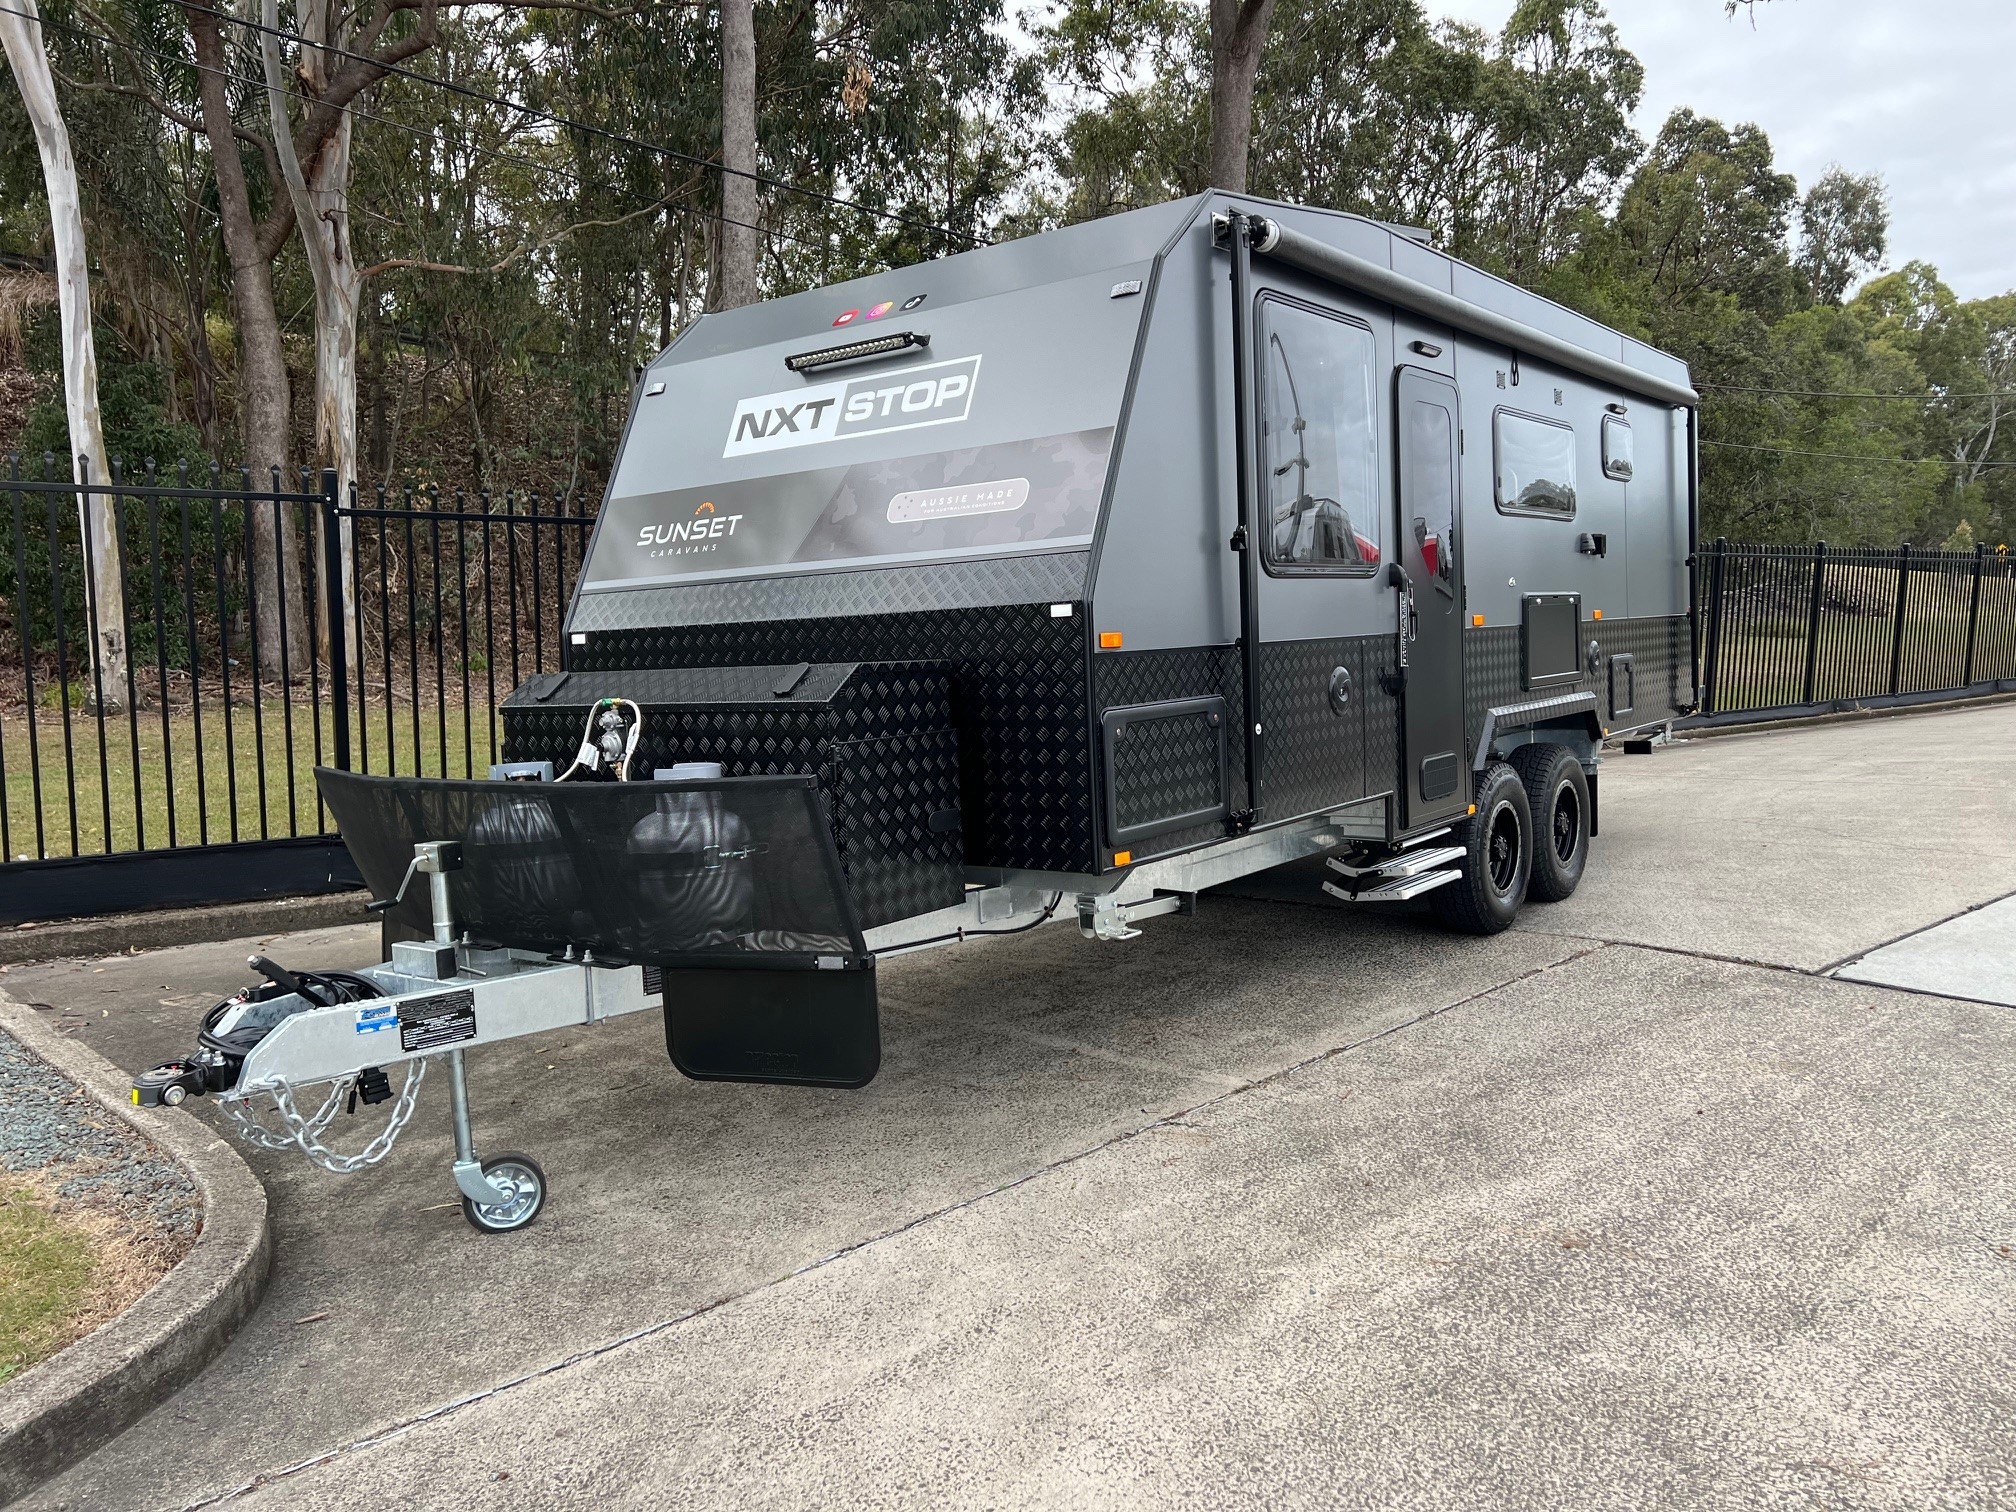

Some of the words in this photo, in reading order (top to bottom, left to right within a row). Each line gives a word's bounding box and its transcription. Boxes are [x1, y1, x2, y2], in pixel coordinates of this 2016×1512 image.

[735, 398, 836, 442] NXT
[844, 374, 969, 422] STOP
[921, 494, 968, 508] AUSSIE
[976, 489, 1014, 501] MADE
[637, 514, 743, 547] SUNSET
[650, 543, 717, 558] CARAVANS
